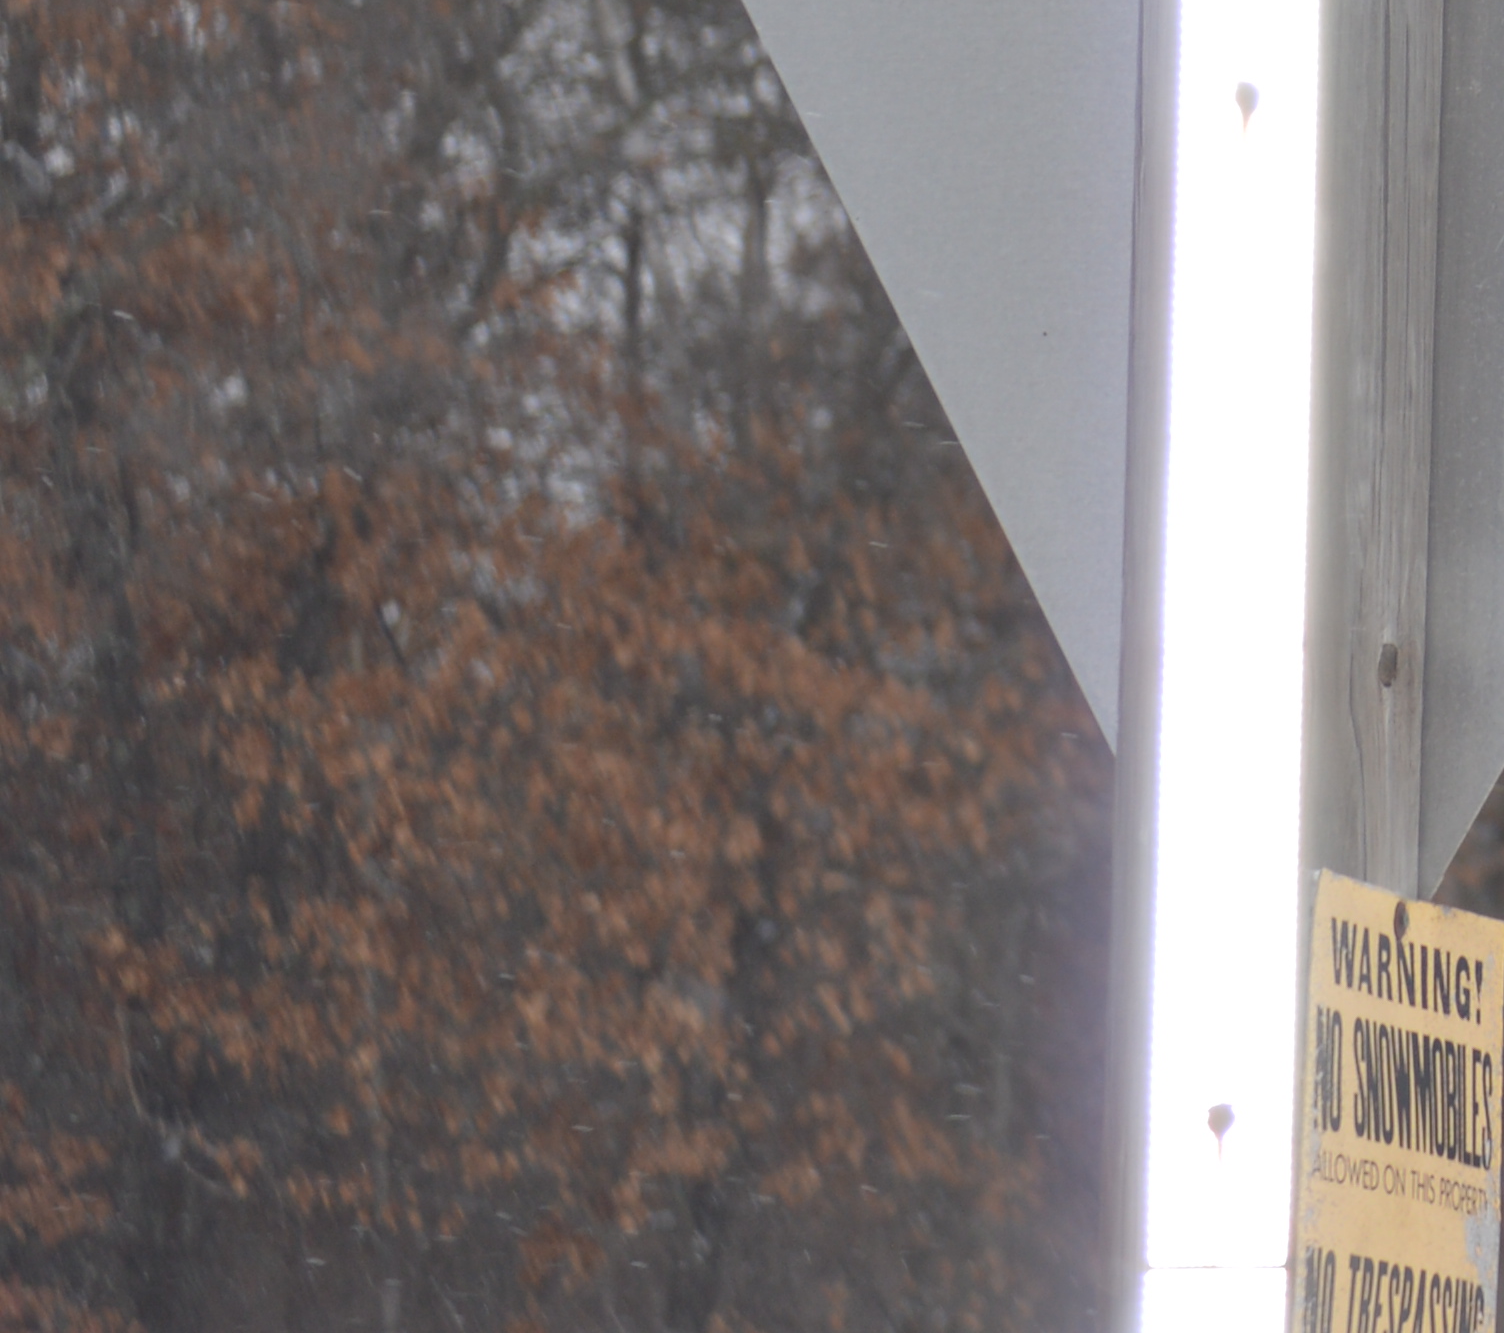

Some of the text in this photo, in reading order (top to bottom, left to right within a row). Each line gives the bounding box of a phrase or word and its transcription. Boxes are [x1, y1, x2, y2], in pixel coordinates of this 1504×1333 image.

[1331, 916, 1484, 1026] WARNING!
[1313, 1004, 1493, 1171] NO SNOWMOBILES
[1311, 1150, 1380, 1192] ALLOWED
[1383, 1164, 1406, 1196] ON
[1411, 1169, 1436, 1204] THIS
[1304, 1244, 1336, 1333] NO
